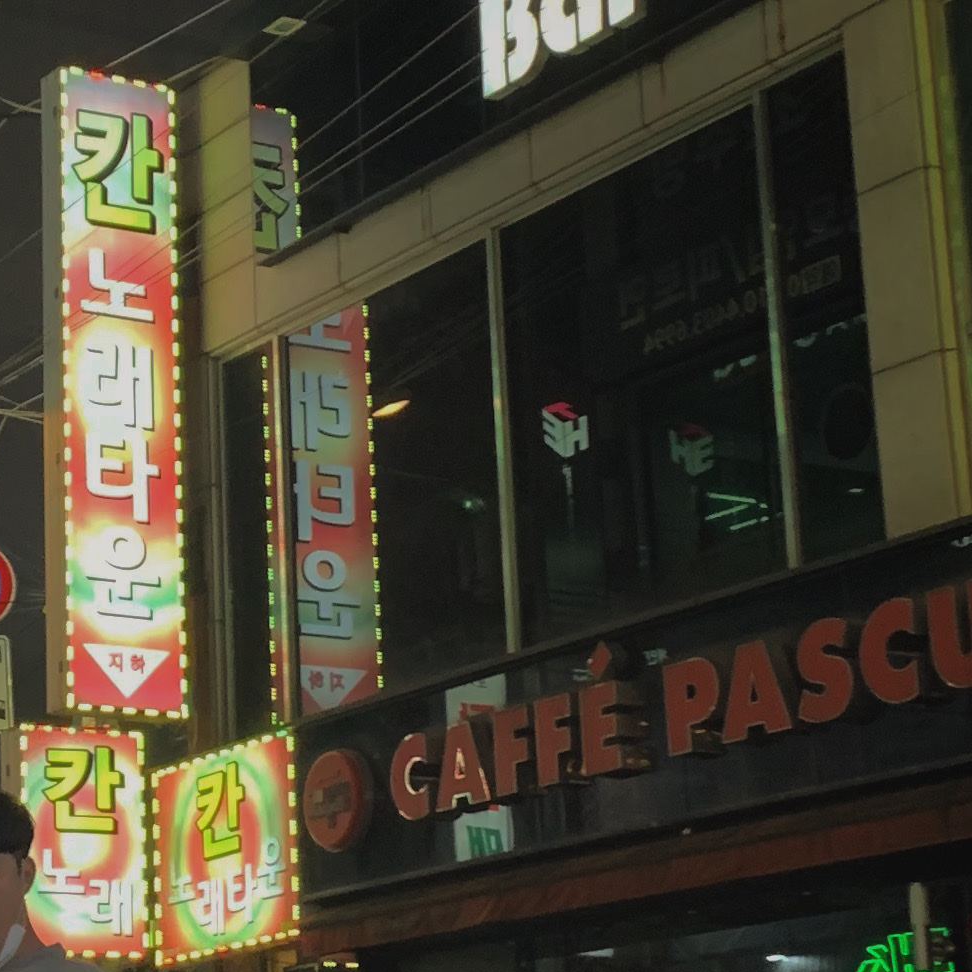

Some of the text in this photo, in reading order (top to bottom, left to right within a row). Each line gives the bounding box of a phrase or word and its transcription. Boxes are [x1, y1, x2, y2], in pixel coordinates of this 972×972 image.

[71, 108, 165, 234] 칸
[80, 247, 162, 622] 노래타운
[108, 652, 145, 674] 지하
[390, 640, 624, 821] CAFFÉ
[42, 745, 125, 835] 칸
[196, 760, 245, 861] 칸
[36, 848, 135, 937] 노래
[169, 838, 287, 937] 노래타운
